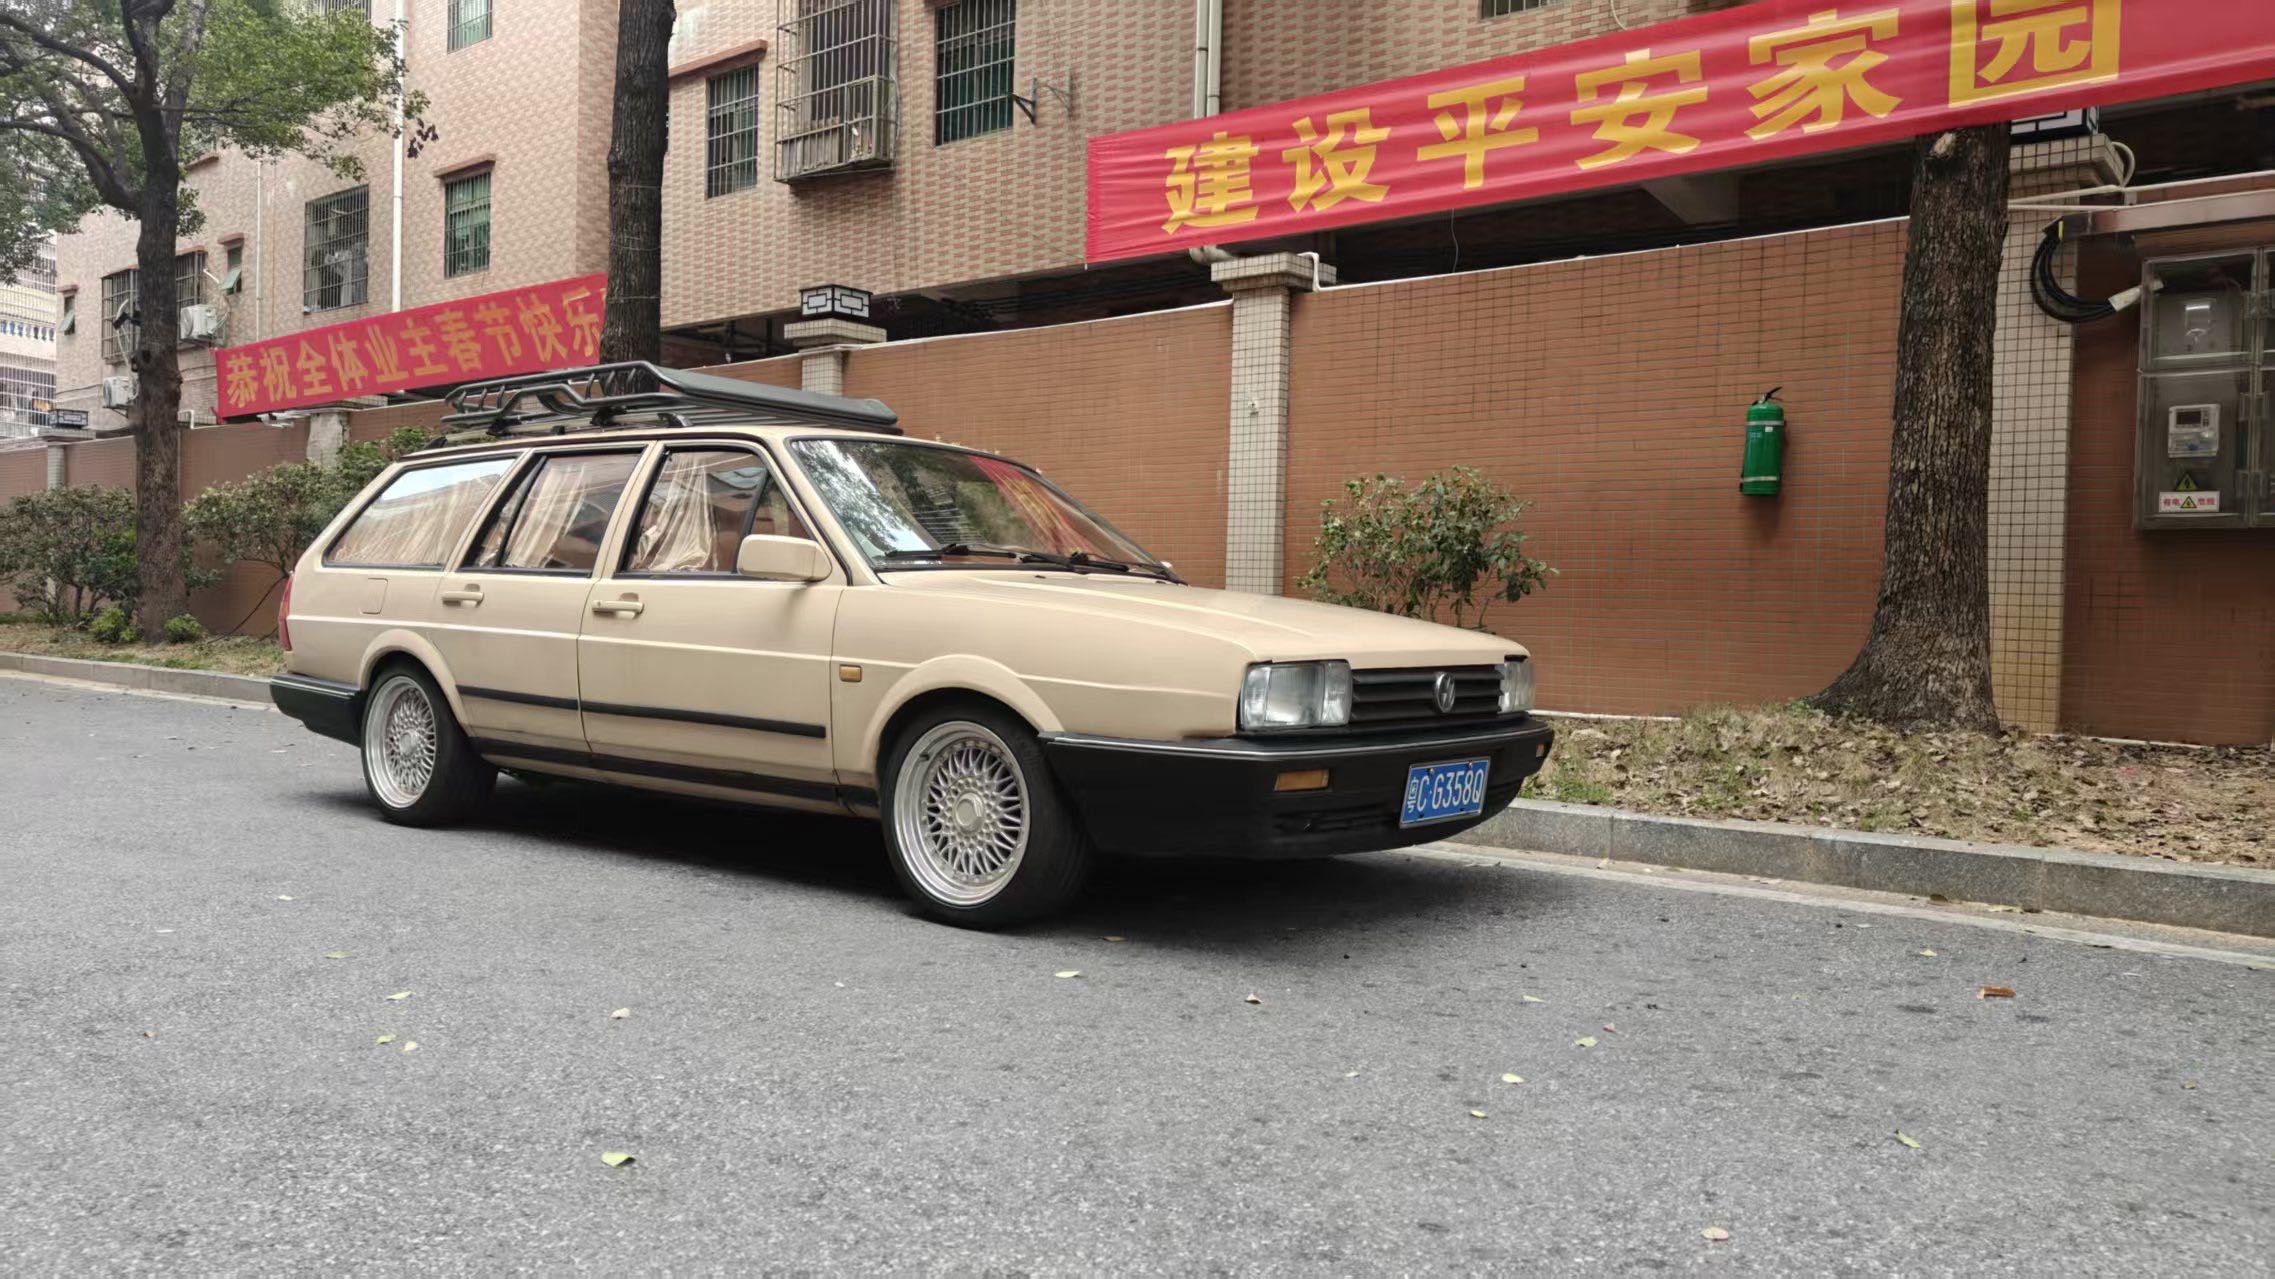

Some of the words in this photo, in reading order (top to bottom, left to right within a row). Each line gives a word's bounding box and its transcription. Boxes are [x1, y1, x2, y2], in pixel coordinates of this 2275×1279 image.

[1161, 0, 2122, 234] 建设平安家园
[226, 286, 607, 408] 恭祝全体业主春节快乐
